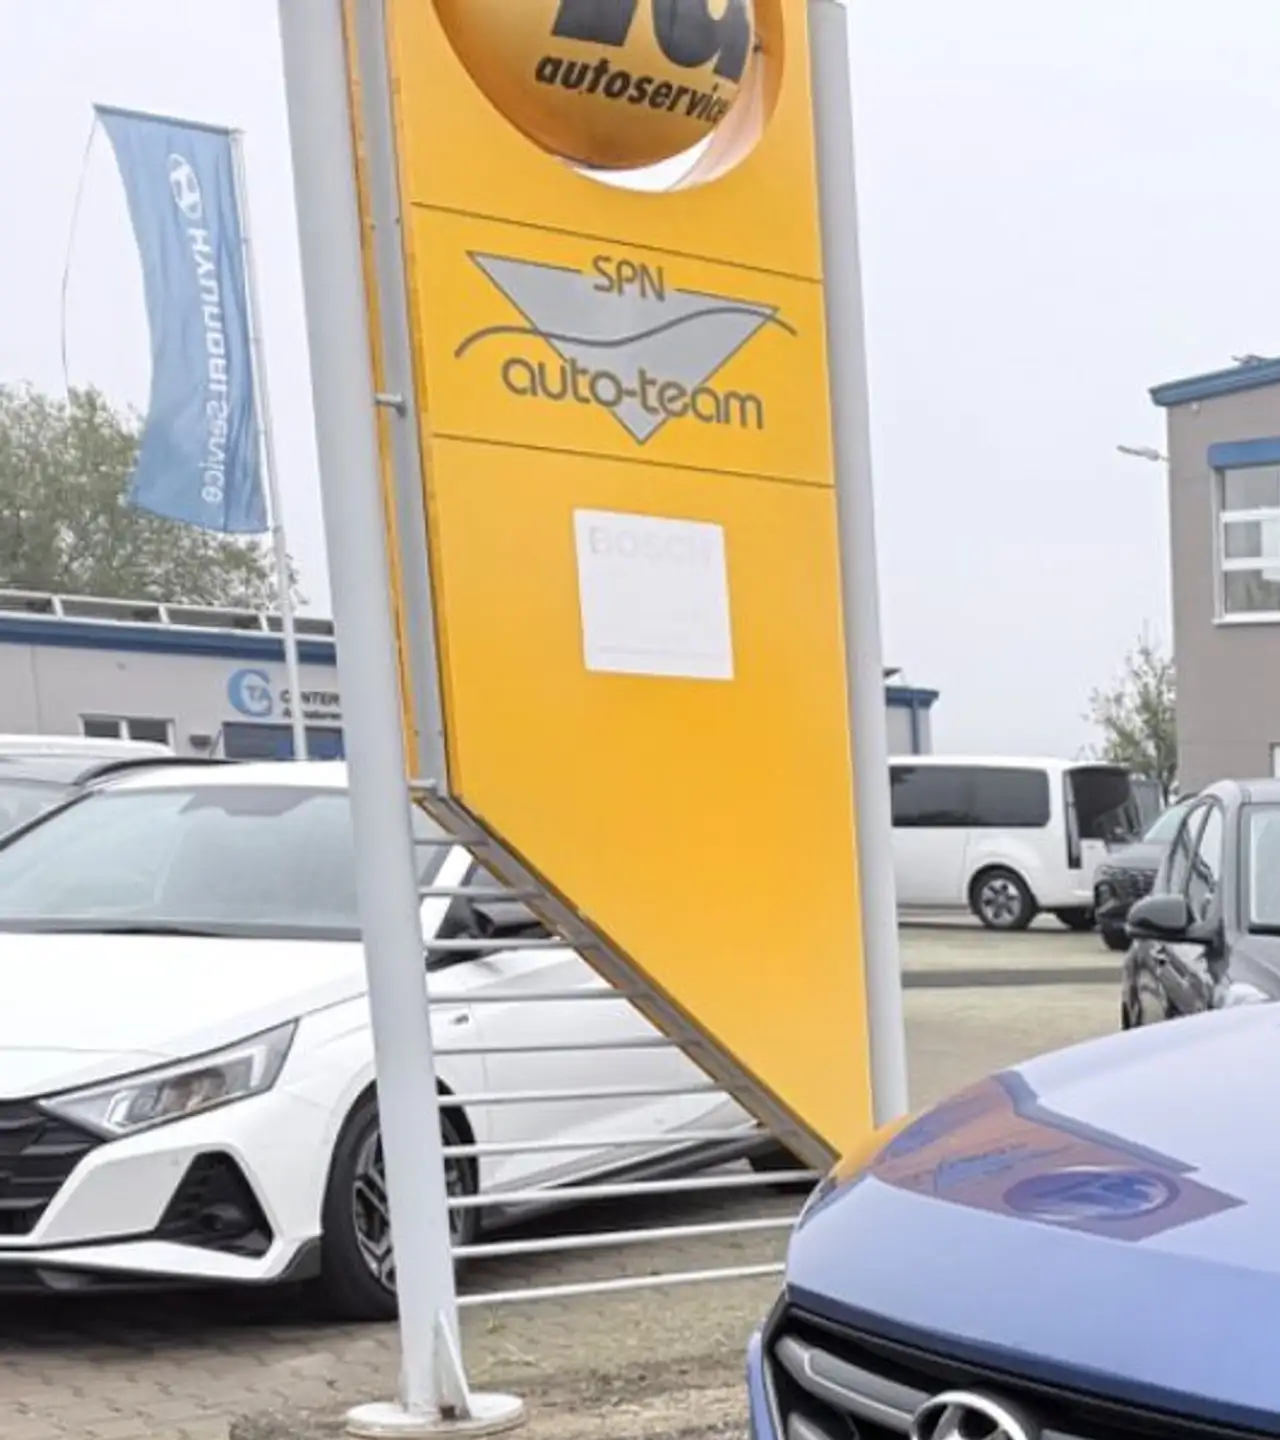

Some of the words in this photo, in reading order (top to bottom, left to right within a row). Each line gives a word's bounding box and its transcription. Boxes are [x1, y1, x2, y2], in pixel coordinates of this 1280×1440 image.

[533, 55, 733, 126] autoservice
[591, 254, 666, 303] SPN
[501, 356, 764, 431] auto-team
[280, 688, 341, 706] CNTER
